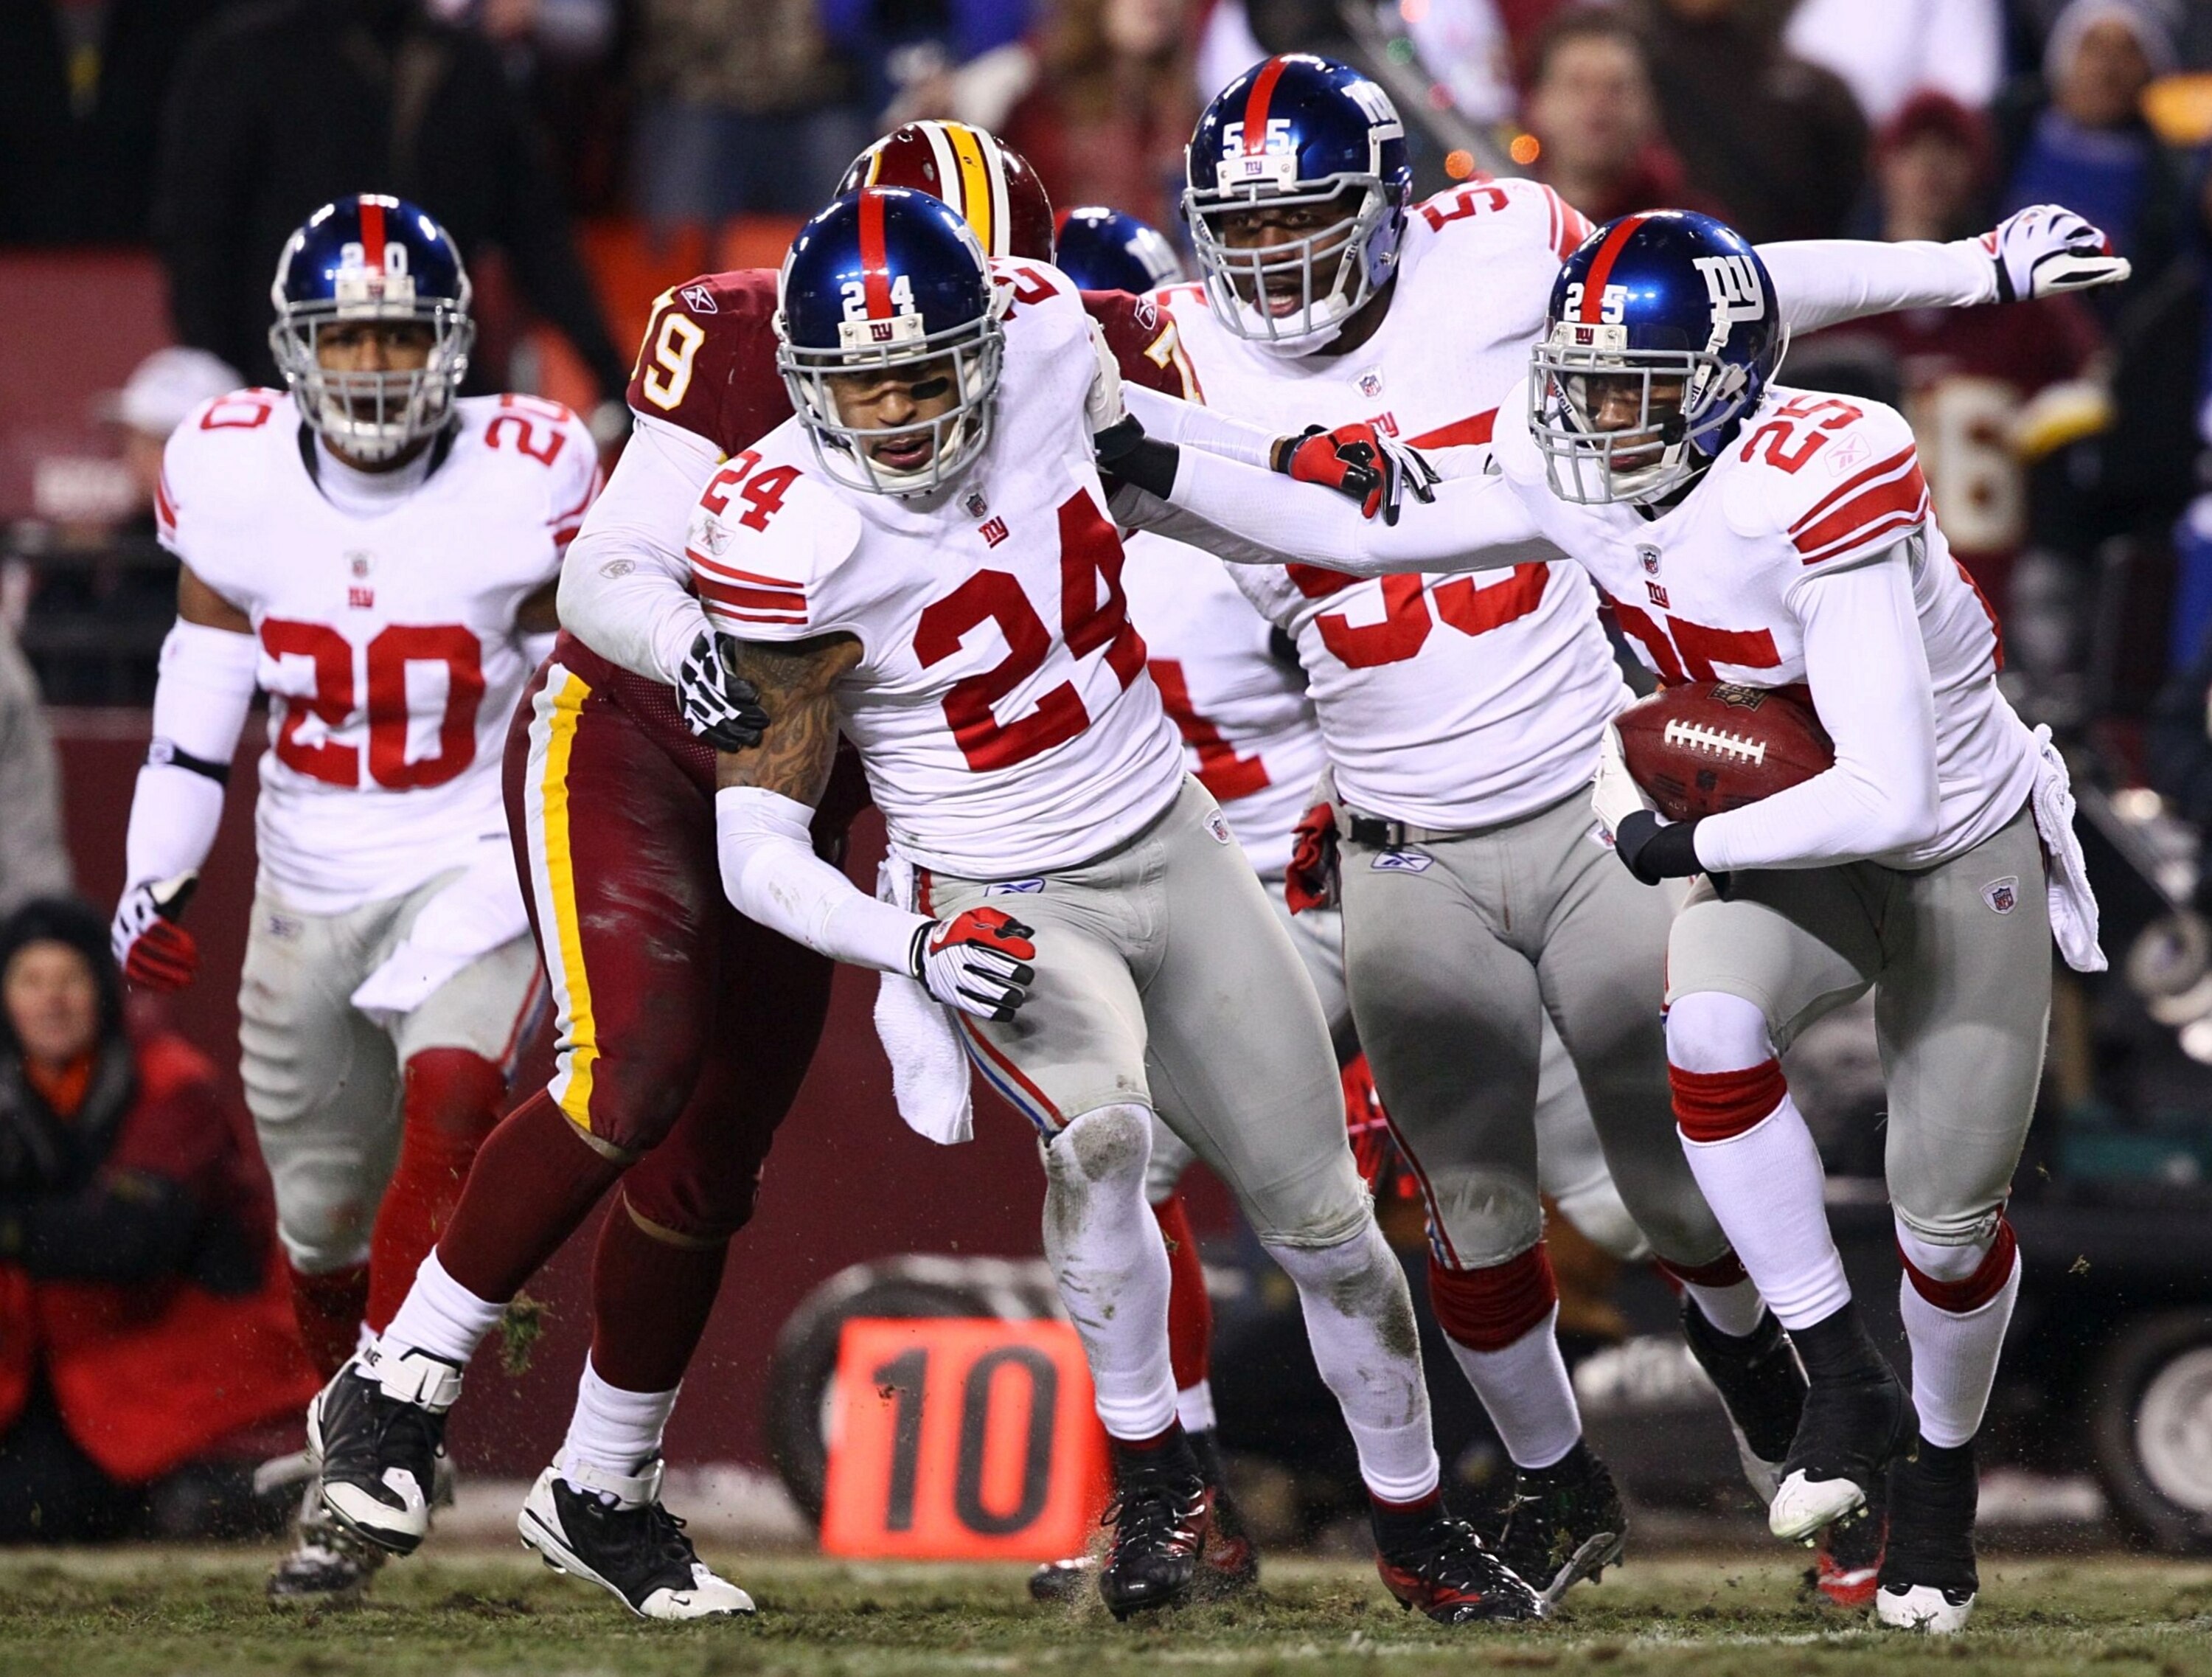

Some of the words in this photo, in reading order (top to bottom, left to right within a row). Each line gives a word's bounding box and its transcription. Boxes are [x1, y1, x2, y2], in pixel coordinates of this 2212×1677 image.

[1222, 119, 1292, 160] 55
[340, 241, 408, 280] 20
[840, 275, 916, 322] 24
[1564, 282, 1628, 324] 25
[631, 285, 706, 412] 79
[1740, 395, 1863, 474] 25
[700, 450, 804, 532] 24
[912, 485, 1148, 773] 24
[260, 617, 486, 791] 20
[872, 1344, 1058, 1535] 10
